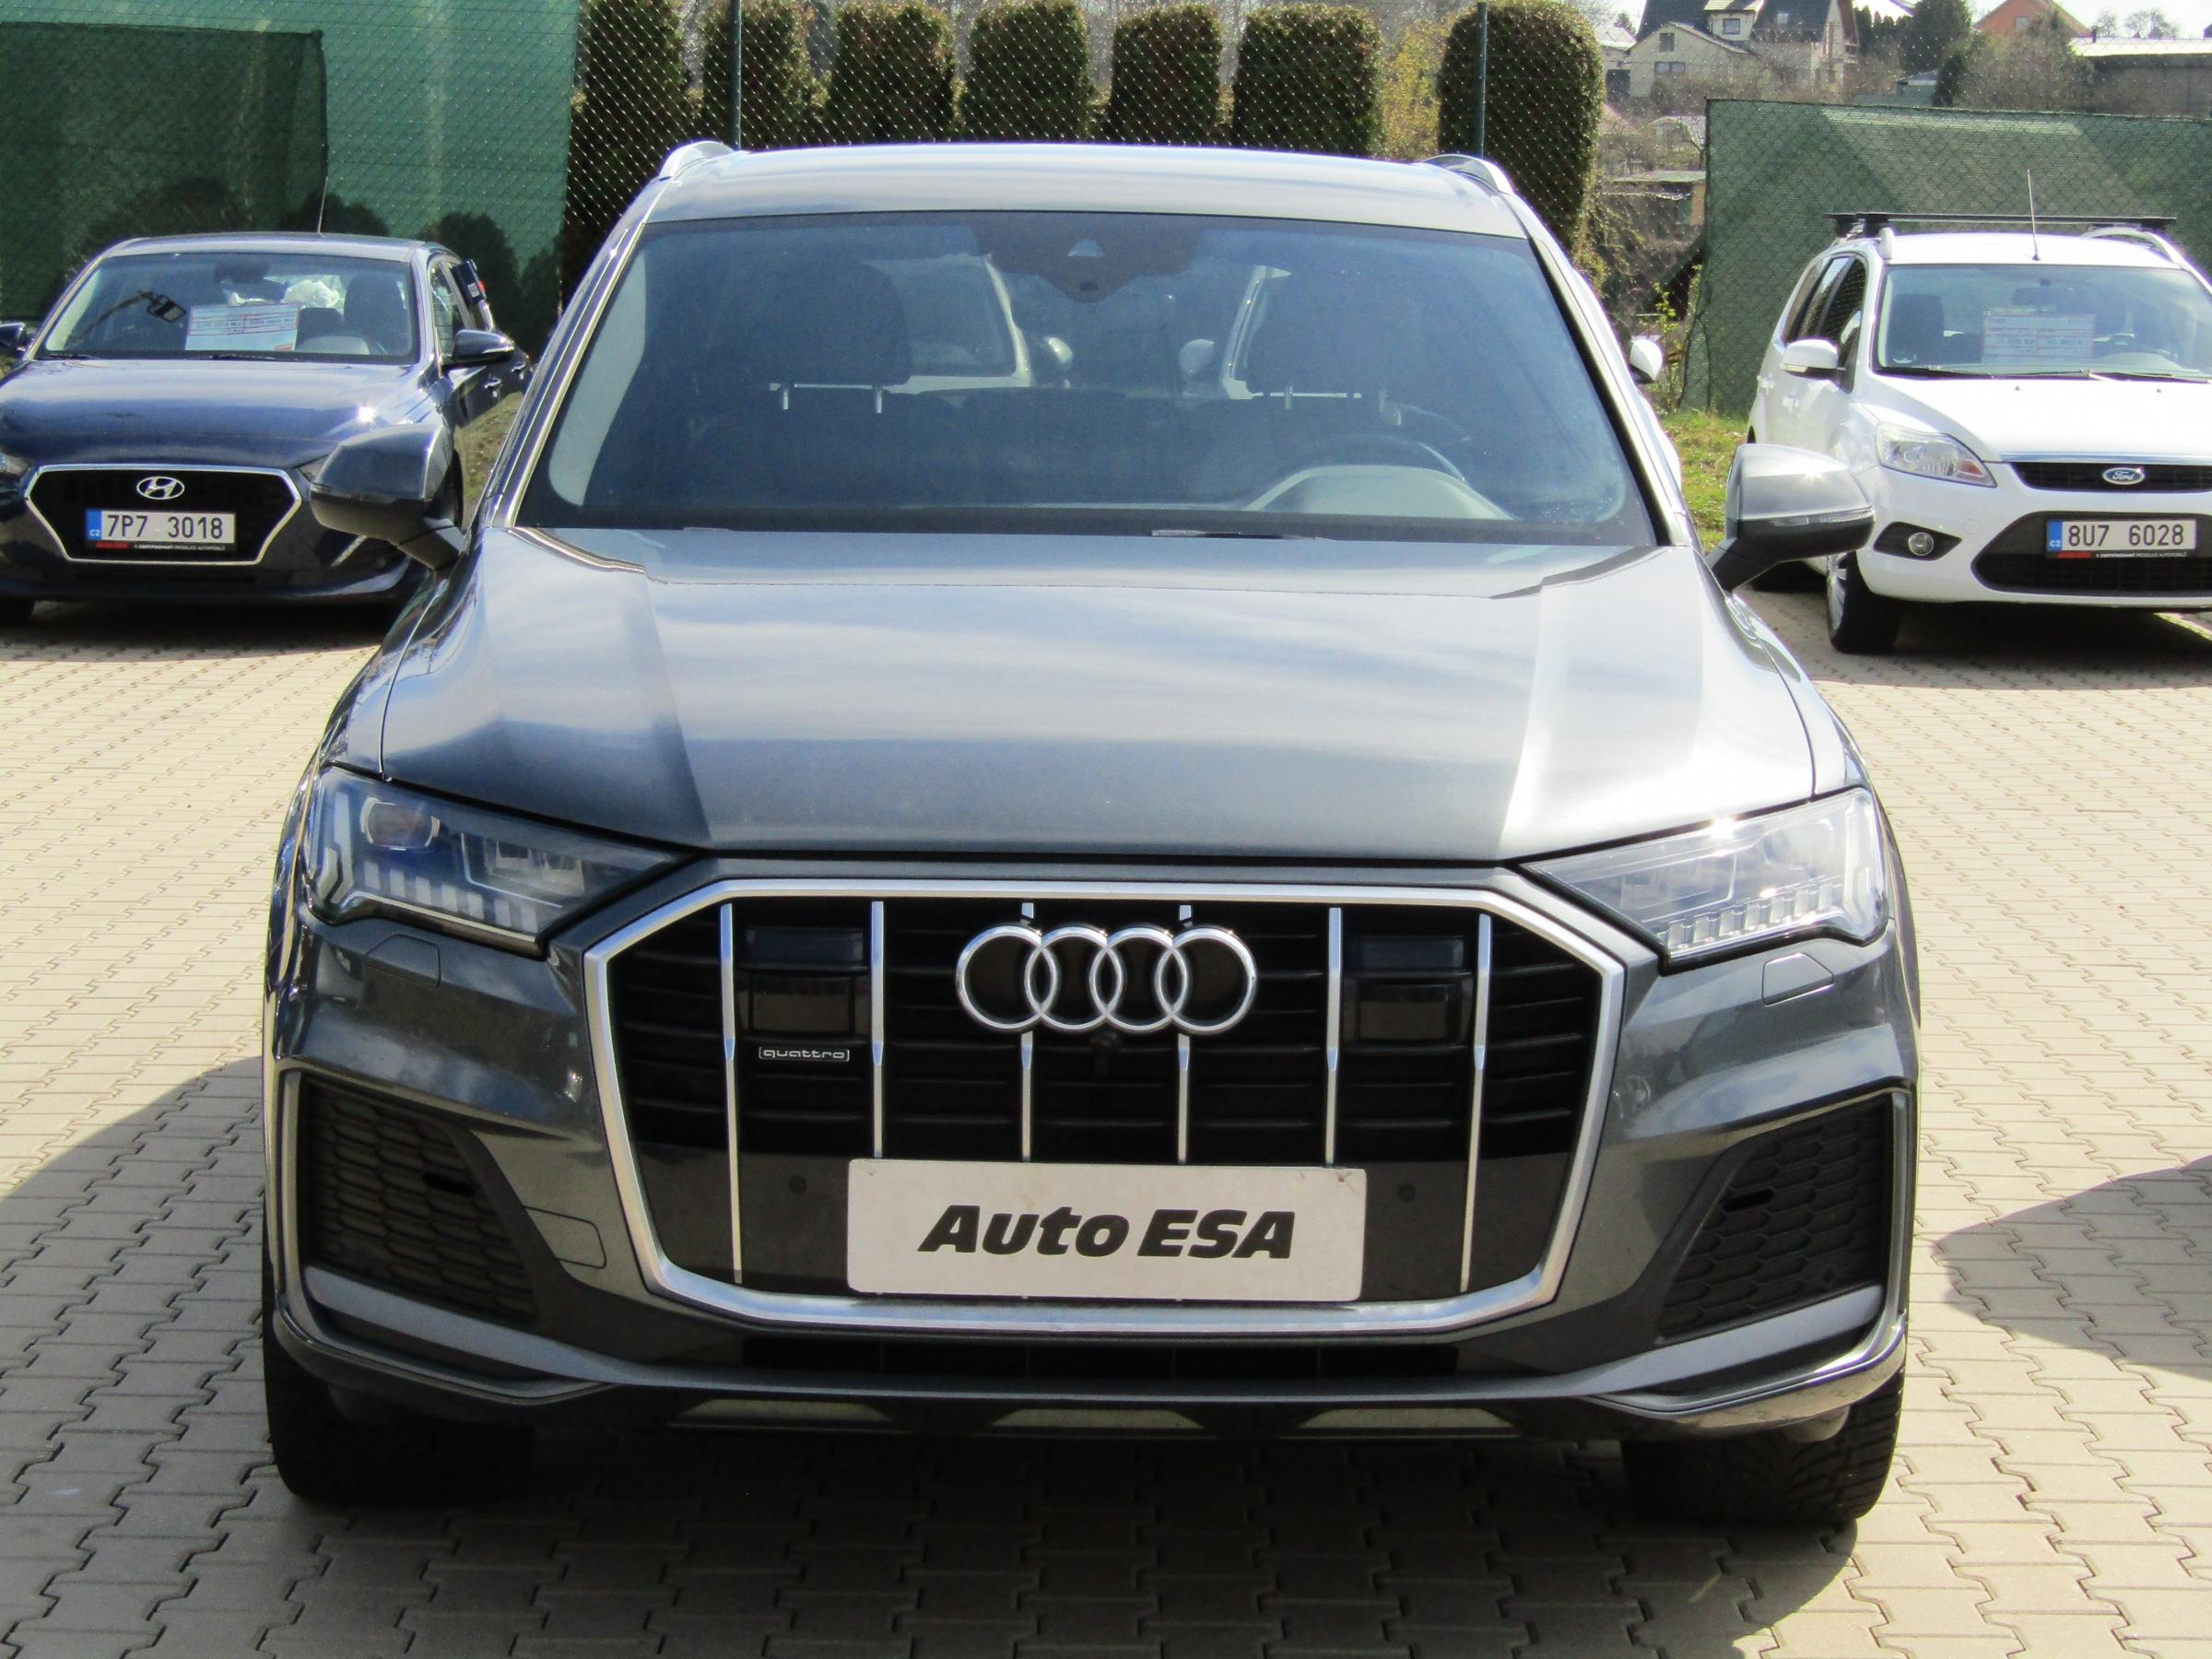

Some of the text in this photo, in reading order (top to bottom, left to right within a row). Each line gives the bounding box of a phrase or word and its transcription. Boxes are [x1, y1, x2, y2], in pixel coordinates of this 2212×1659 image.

[2112, 471, 2136, 480] Ford
[107, 514, 223, 539] 7P7 3018
[89, 529, 101, 537] CZ
[2067, 524, 2184, 547] 8U7 6028
[2049, 539, 2062, 547] CZ
[762, 1049, 846, 1059] quattro
[916, 1205, 1296, 1259] Auto ESA
